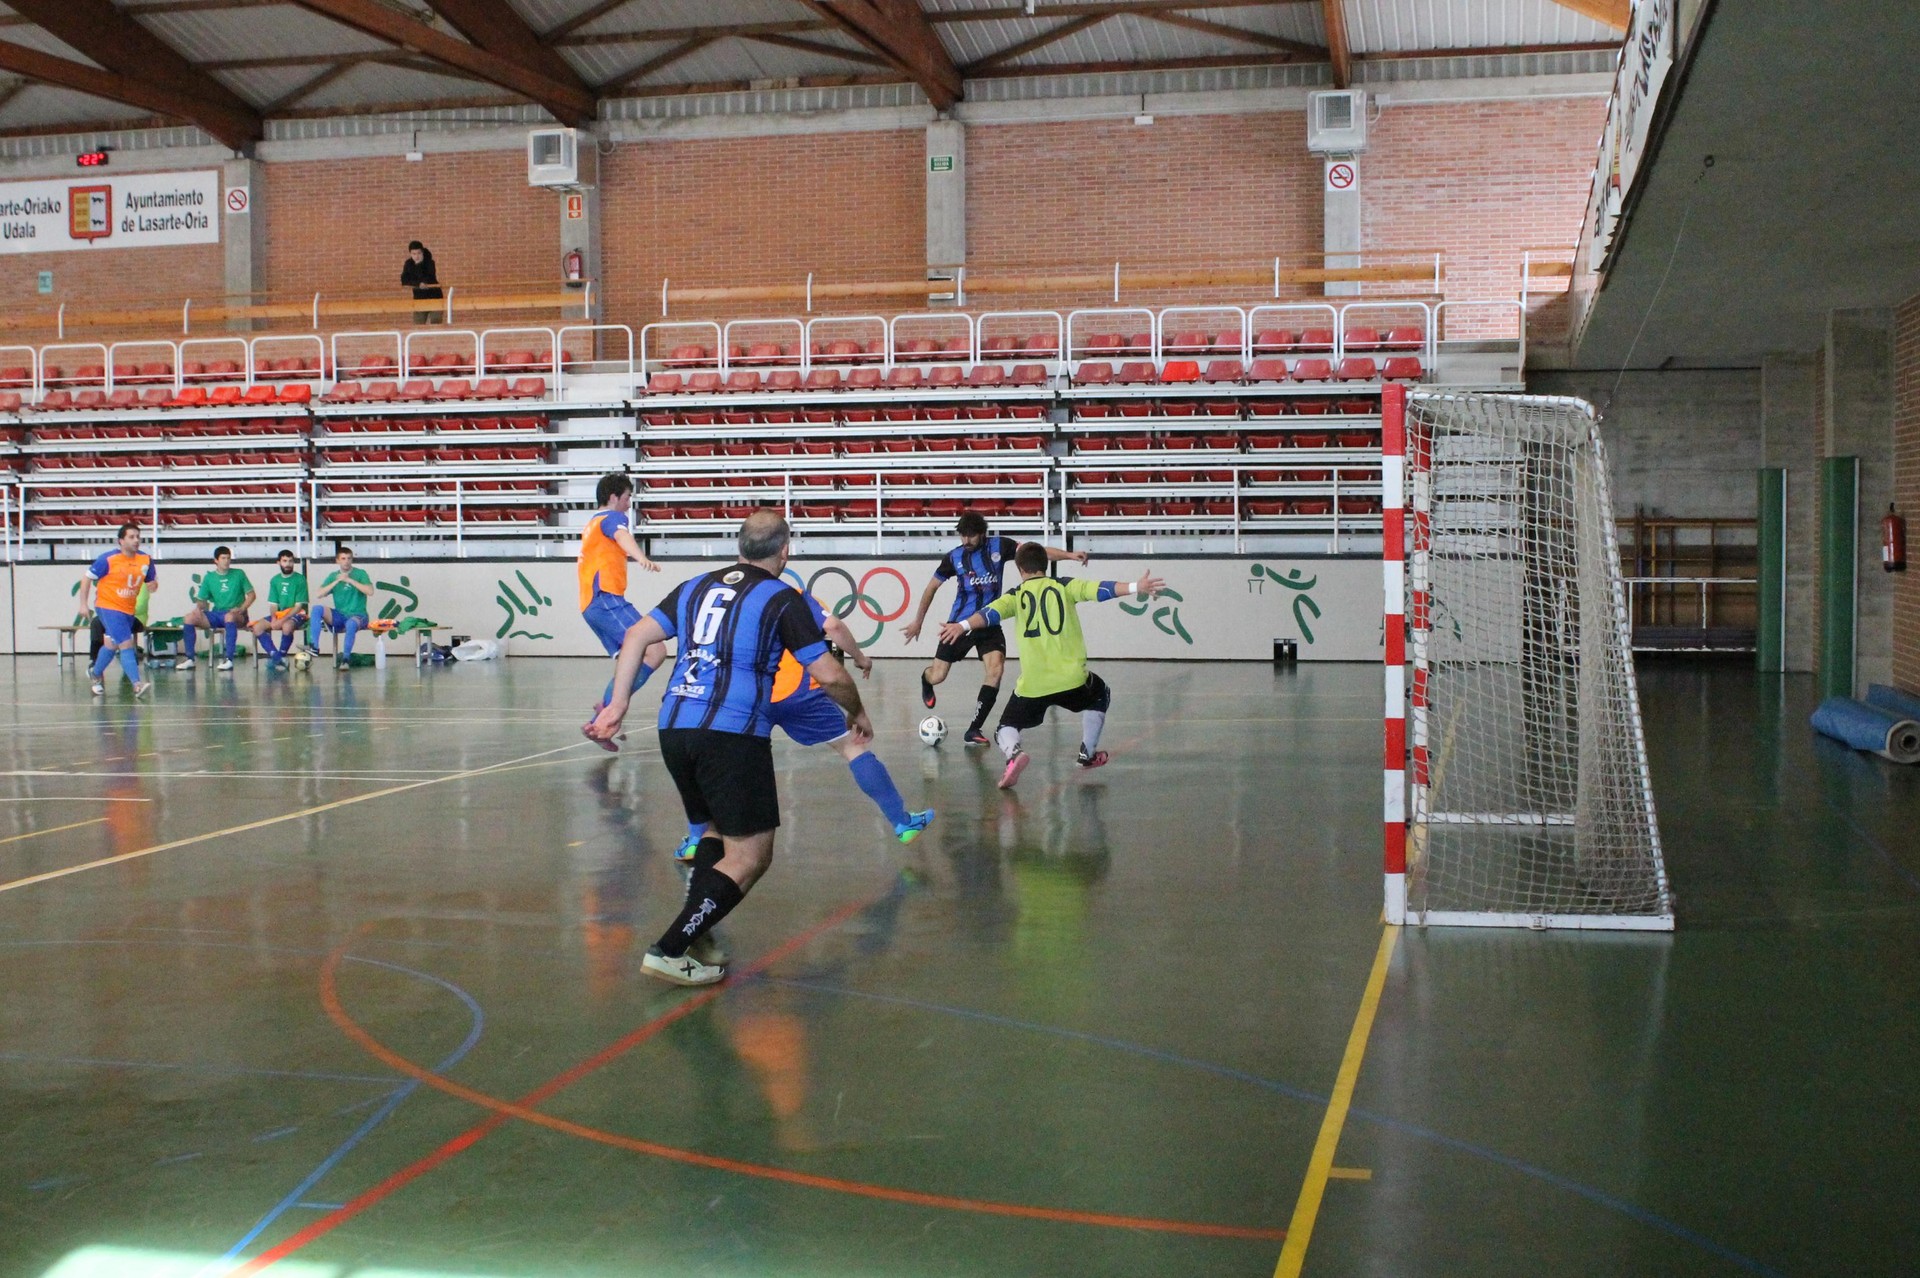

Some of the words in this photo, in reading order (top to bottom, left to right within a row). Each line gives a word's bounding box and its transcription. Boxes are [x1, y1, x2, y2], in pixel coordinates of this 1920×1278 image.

[126, 188, 203, 212] Ayuntamiento
[3, 221, 36, 239] Udala
[121, 215, 135, 232] de
[139, 211, 208, 232] Lasarte-Oria
[692, 587, 737, 645] 6
[1021, 586, 1065, 638] 20
